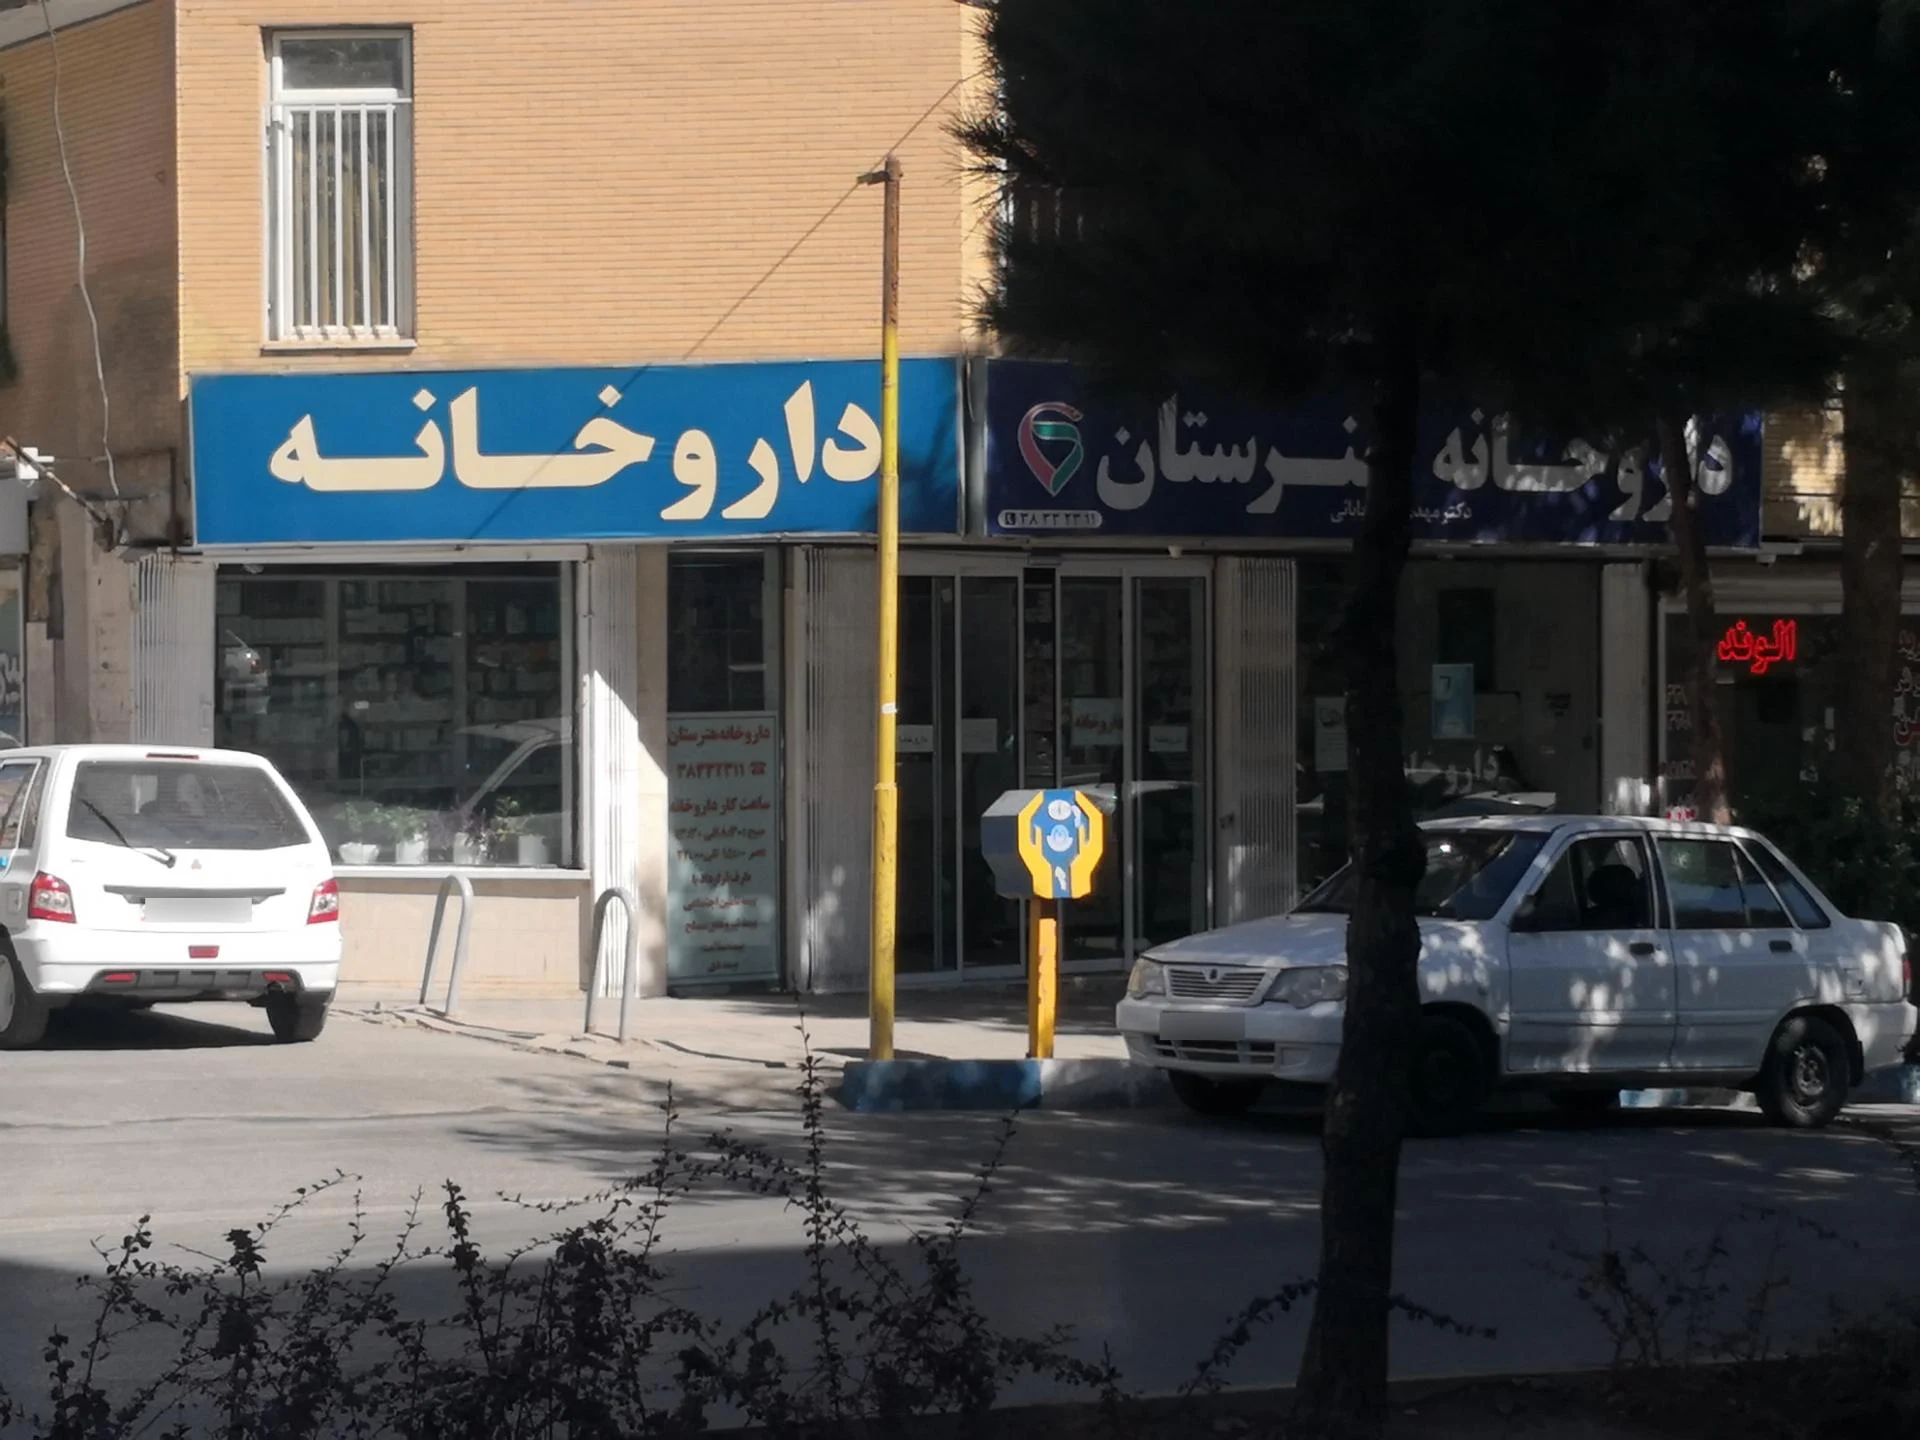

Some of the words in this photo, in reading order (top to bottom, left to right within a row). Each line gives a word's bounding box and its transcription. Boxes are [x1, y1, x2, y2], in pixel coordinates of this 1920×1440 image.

[269, 379, 884, 521] داروخانه
[1095, 391, 1374, 515] نرستان
[1409, 504, 1440, 523] مهد
[1716, 617, 1798, 676] الوند
